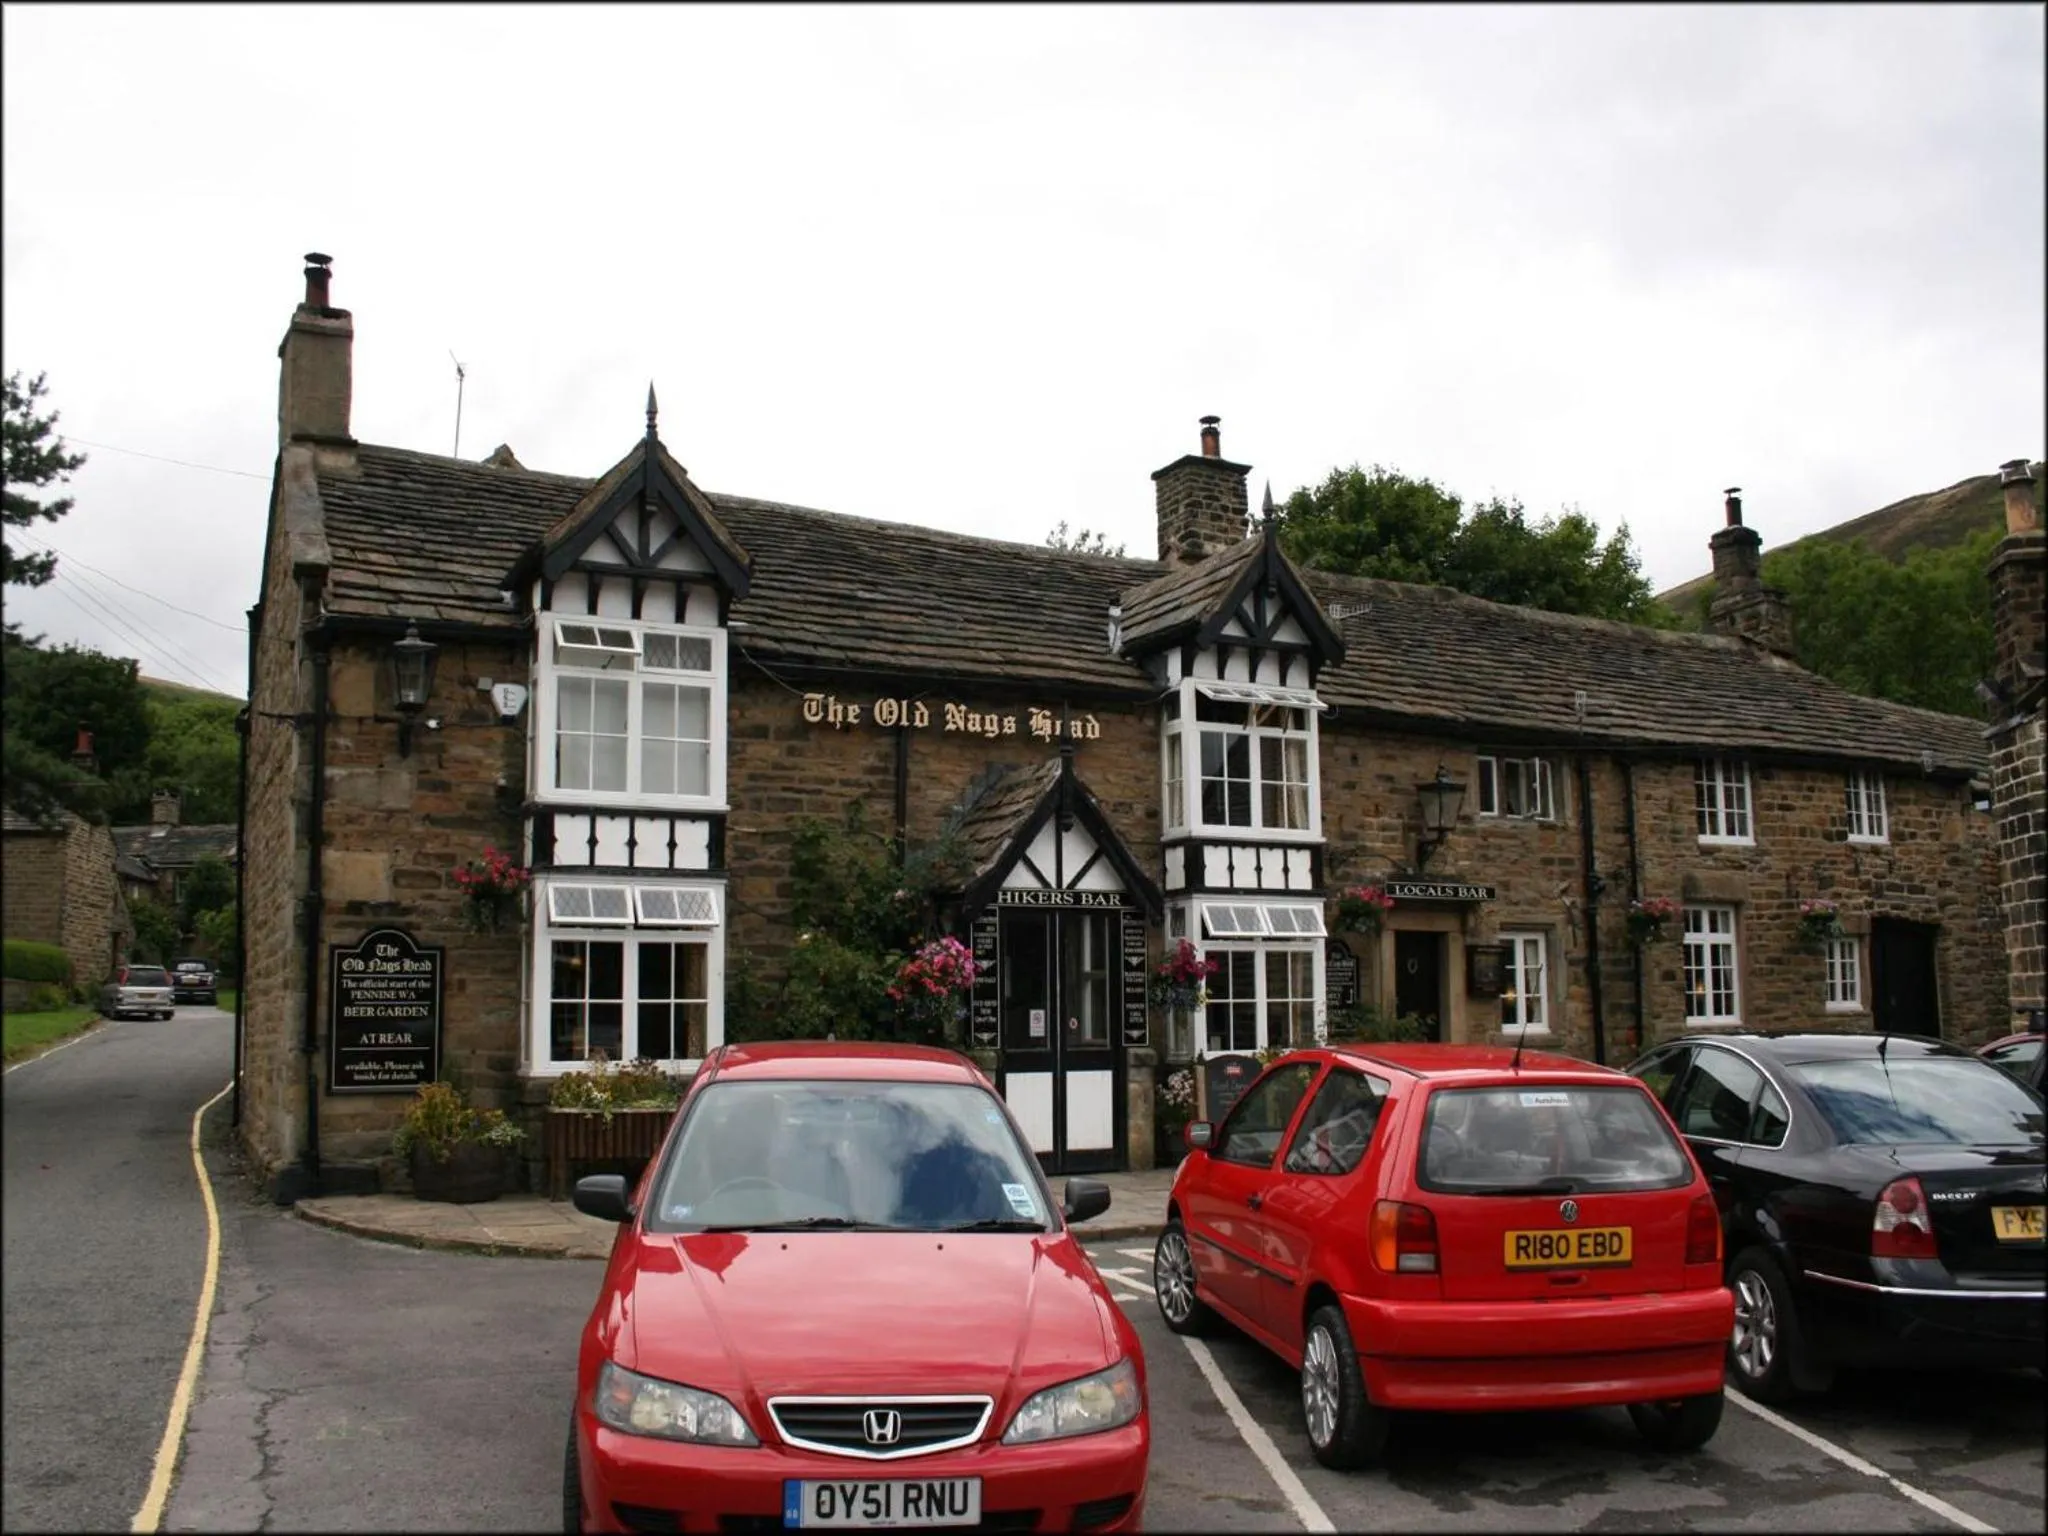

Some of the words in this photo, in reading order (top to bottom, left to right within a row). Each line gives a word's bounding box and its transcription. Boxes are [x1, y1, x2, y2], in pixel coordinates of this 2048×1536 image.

[803, 693, 861, 729] The
[873, 698, 929, 727] Old
[944, 702, 1016, 738] Nags
[1395, 884, 1454, 897] LOCALS
[1458, 887, 1488, 898] BAR
[997, 891, 1074, 905] HIKERS
[1080, 893, 1121, 906] BAR
[376, 944, 399, 957] The
[342, 958, 364, 972] Old
[367, 958, 400, 973] Nags
[403, 959, 432, 973] Head
[351, 990, 397, 999] PENNINE
[344, 1007, 375, 1017] BEER
[376, 1006, 429, 1017] GARDEN
[360, 1033, 378, 1044] AT
[379, 1033, 412, 1043] REAR
[1515, 1233, 1570, 1260] R180
[1577, 1231, 1623, 1258] EBD
[815, 1482, 891, 1519] OY51
[903, 1481, 969, 1517] RNU
